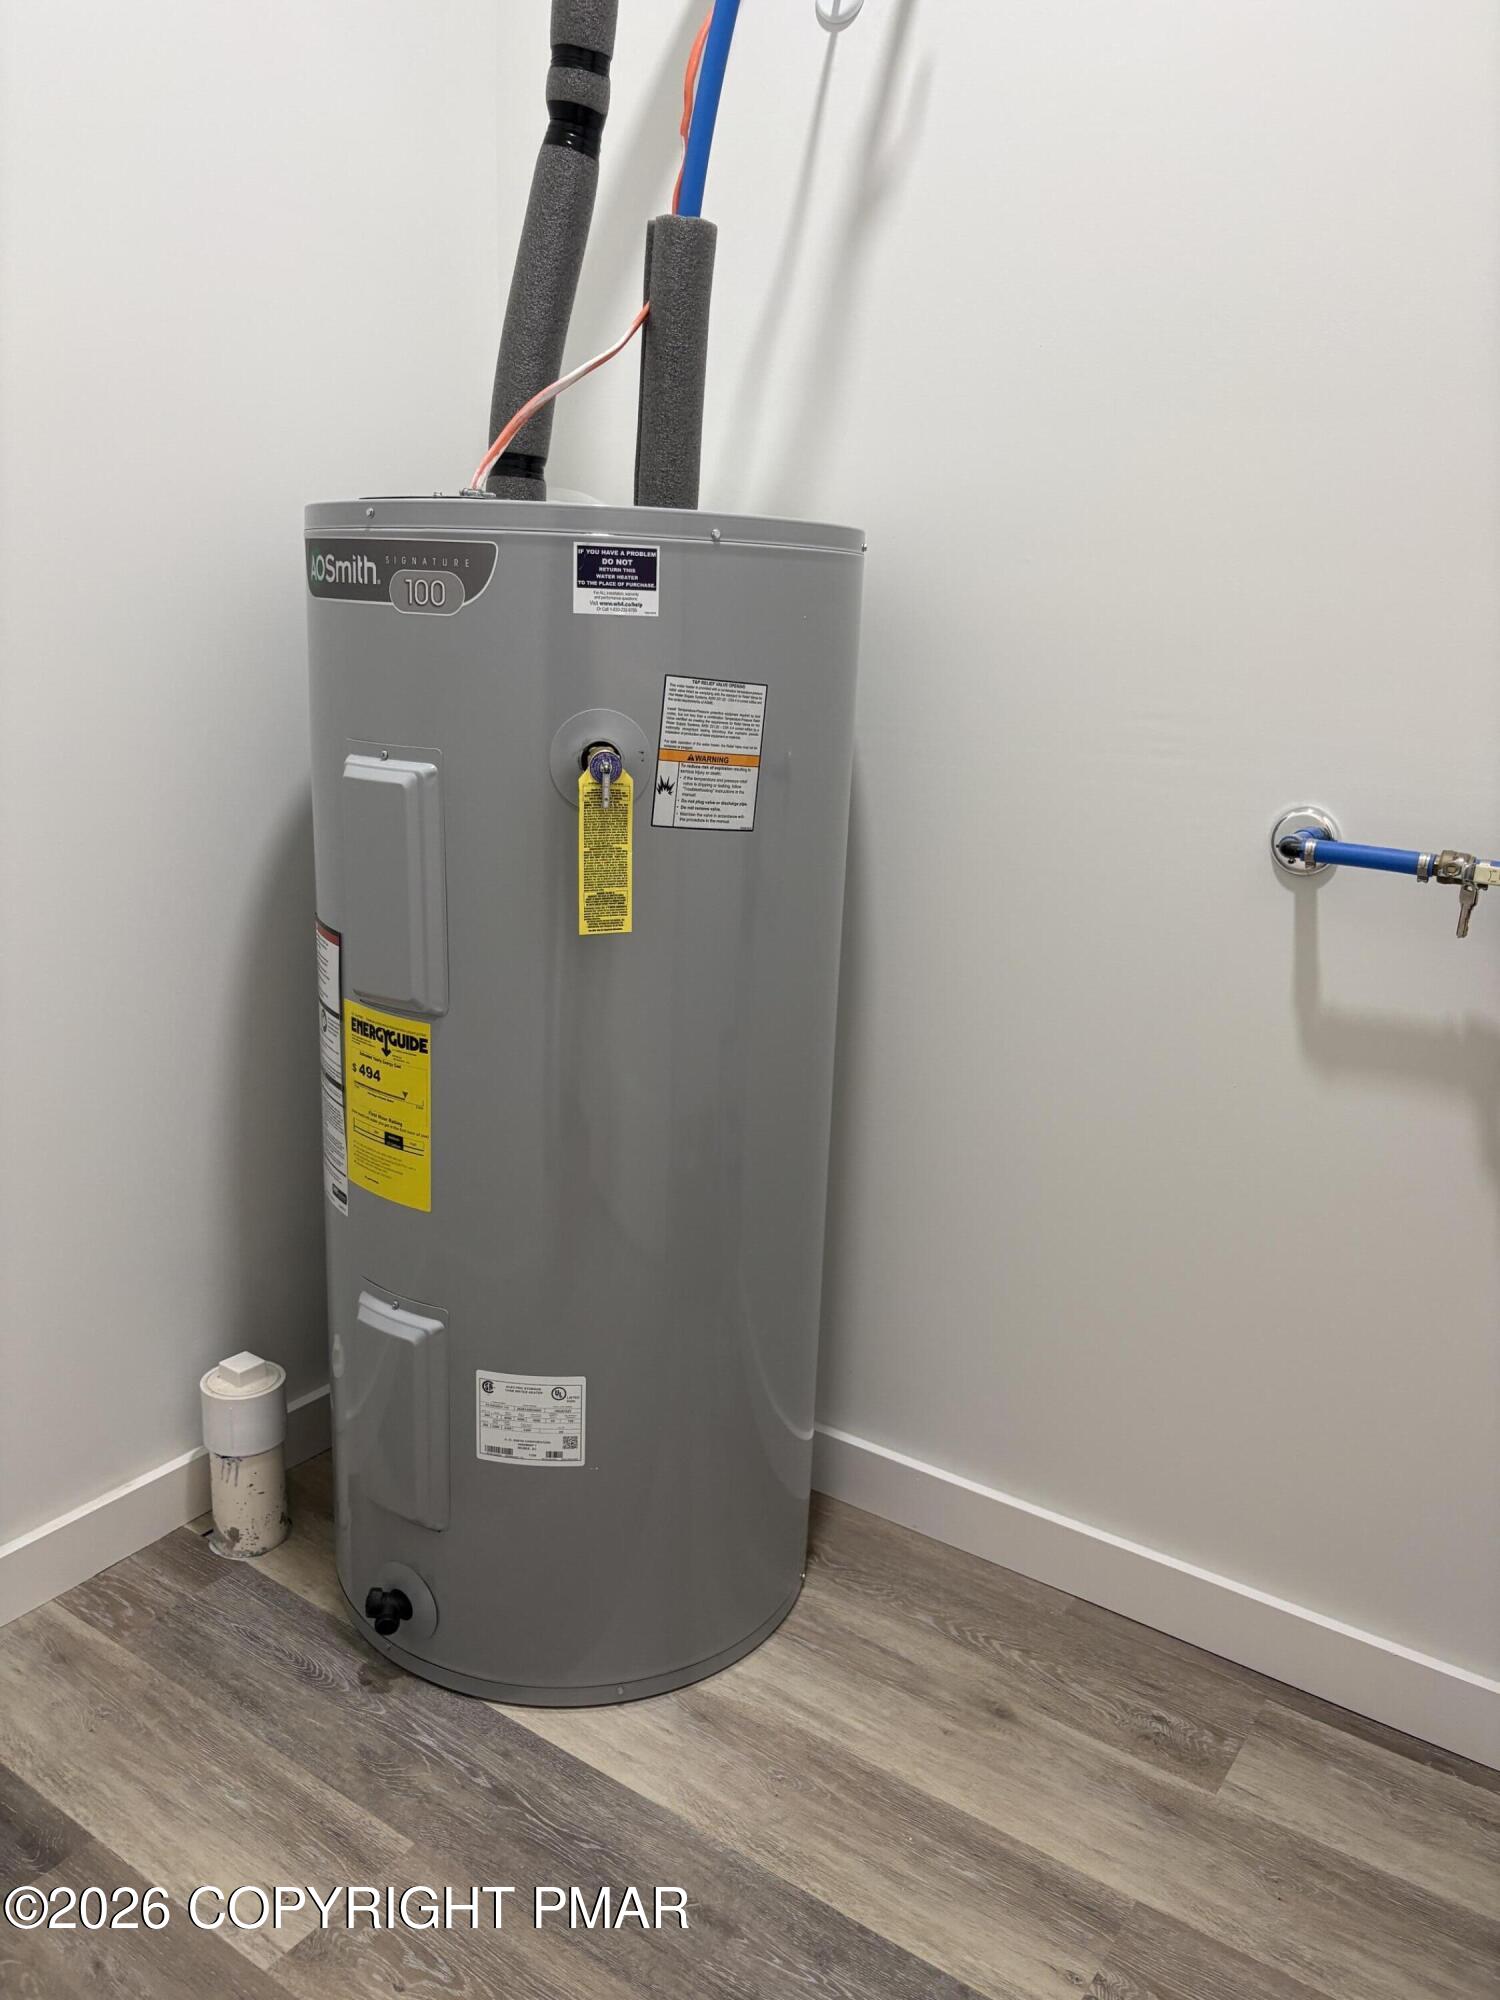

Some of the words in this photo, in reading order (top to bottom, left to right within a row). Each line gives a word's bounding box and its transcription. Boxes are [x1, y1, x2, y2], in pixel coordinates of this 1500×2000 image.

[385, 556, 470, 567] SIGNATURE
[405, 579, 446, 606] 100
[695, 755, 729, 763] WARNING
[351, 1017, 428, 1054] ENERGYGUIDE
